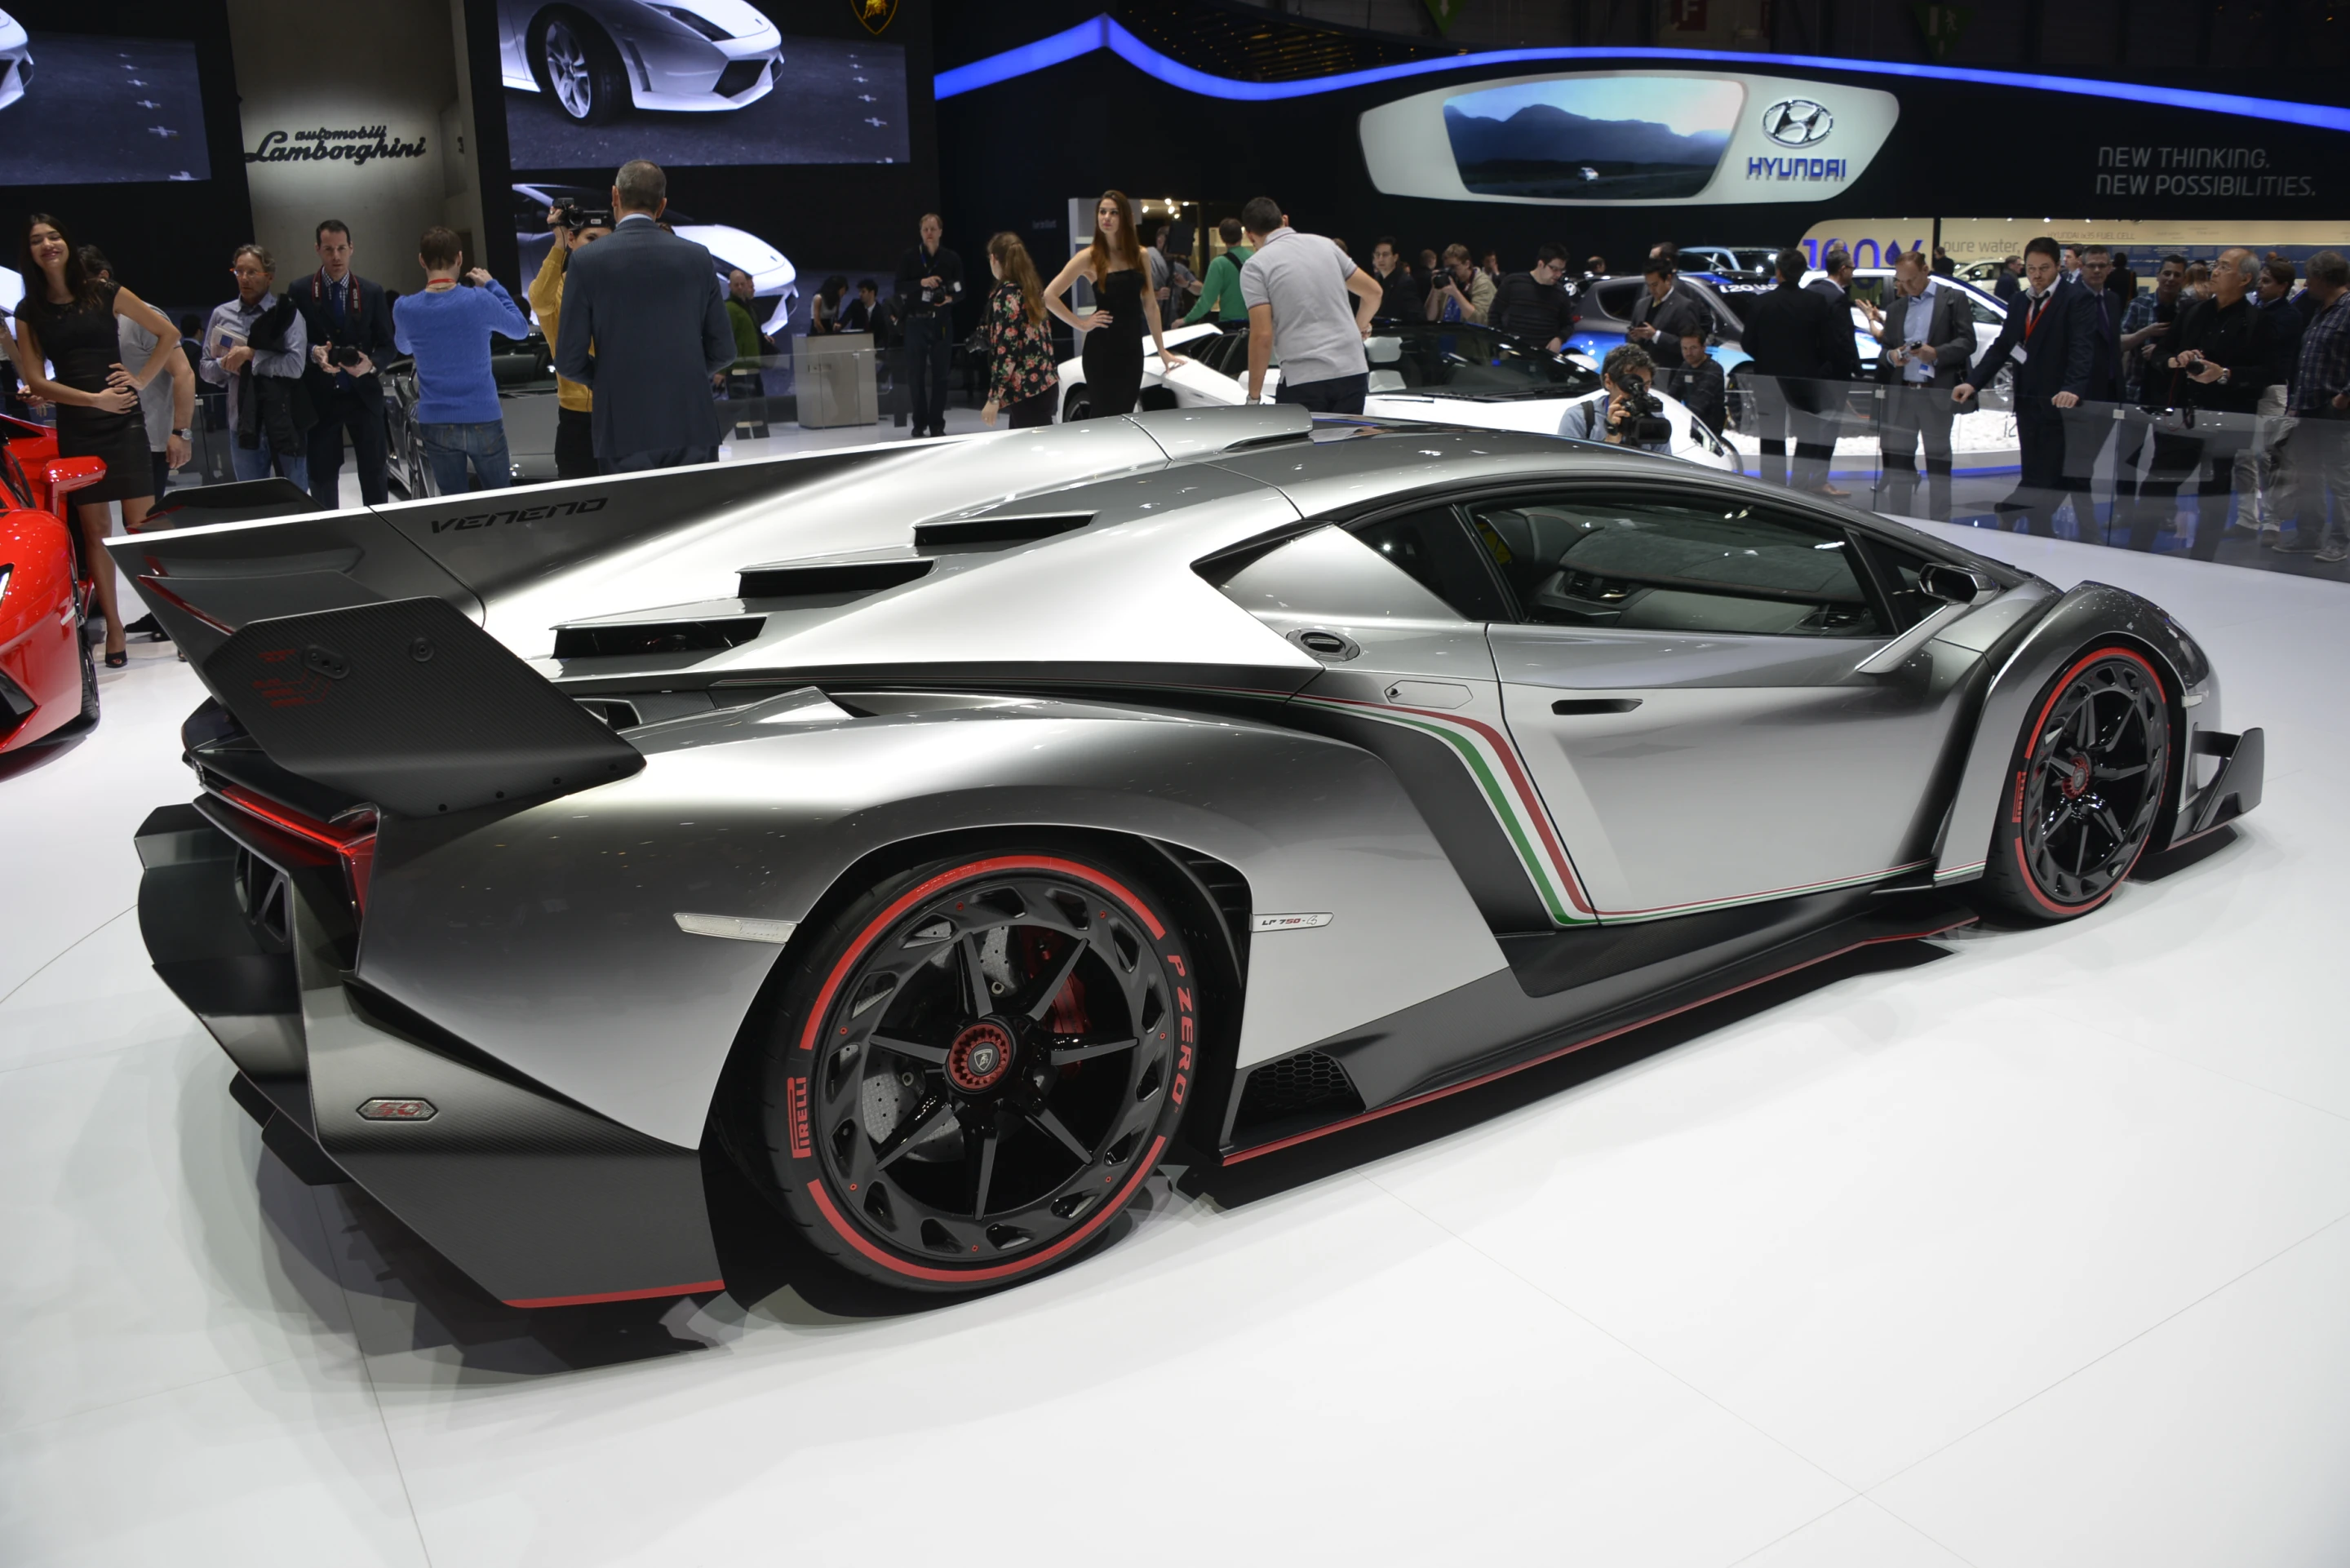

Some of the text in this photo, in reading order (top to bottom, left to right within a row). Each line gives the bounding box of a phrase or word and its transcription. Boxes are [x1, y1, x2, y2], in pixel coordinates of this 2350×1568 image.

[295, 126, 387, 141] automobili
[245, 131, 426, 166] Lamborghini
[2098, 147, 2271, 169] NEW THINKING.
[1748, 157, 1847, 178] HYUNDAI
[2095, 175, 2317, 196] NEW POSSIBILITIES.
[2096, 232, 2115, 240] FUEL
[2117, 232, 2135, 240] CELL
[1944, 241, 1975, 254] pure
[431, 498, 609, 534] VENENO
[1172, 986, 1193, 1105] ZERO
[787, 1077, 812, 1158] PIRELLI
